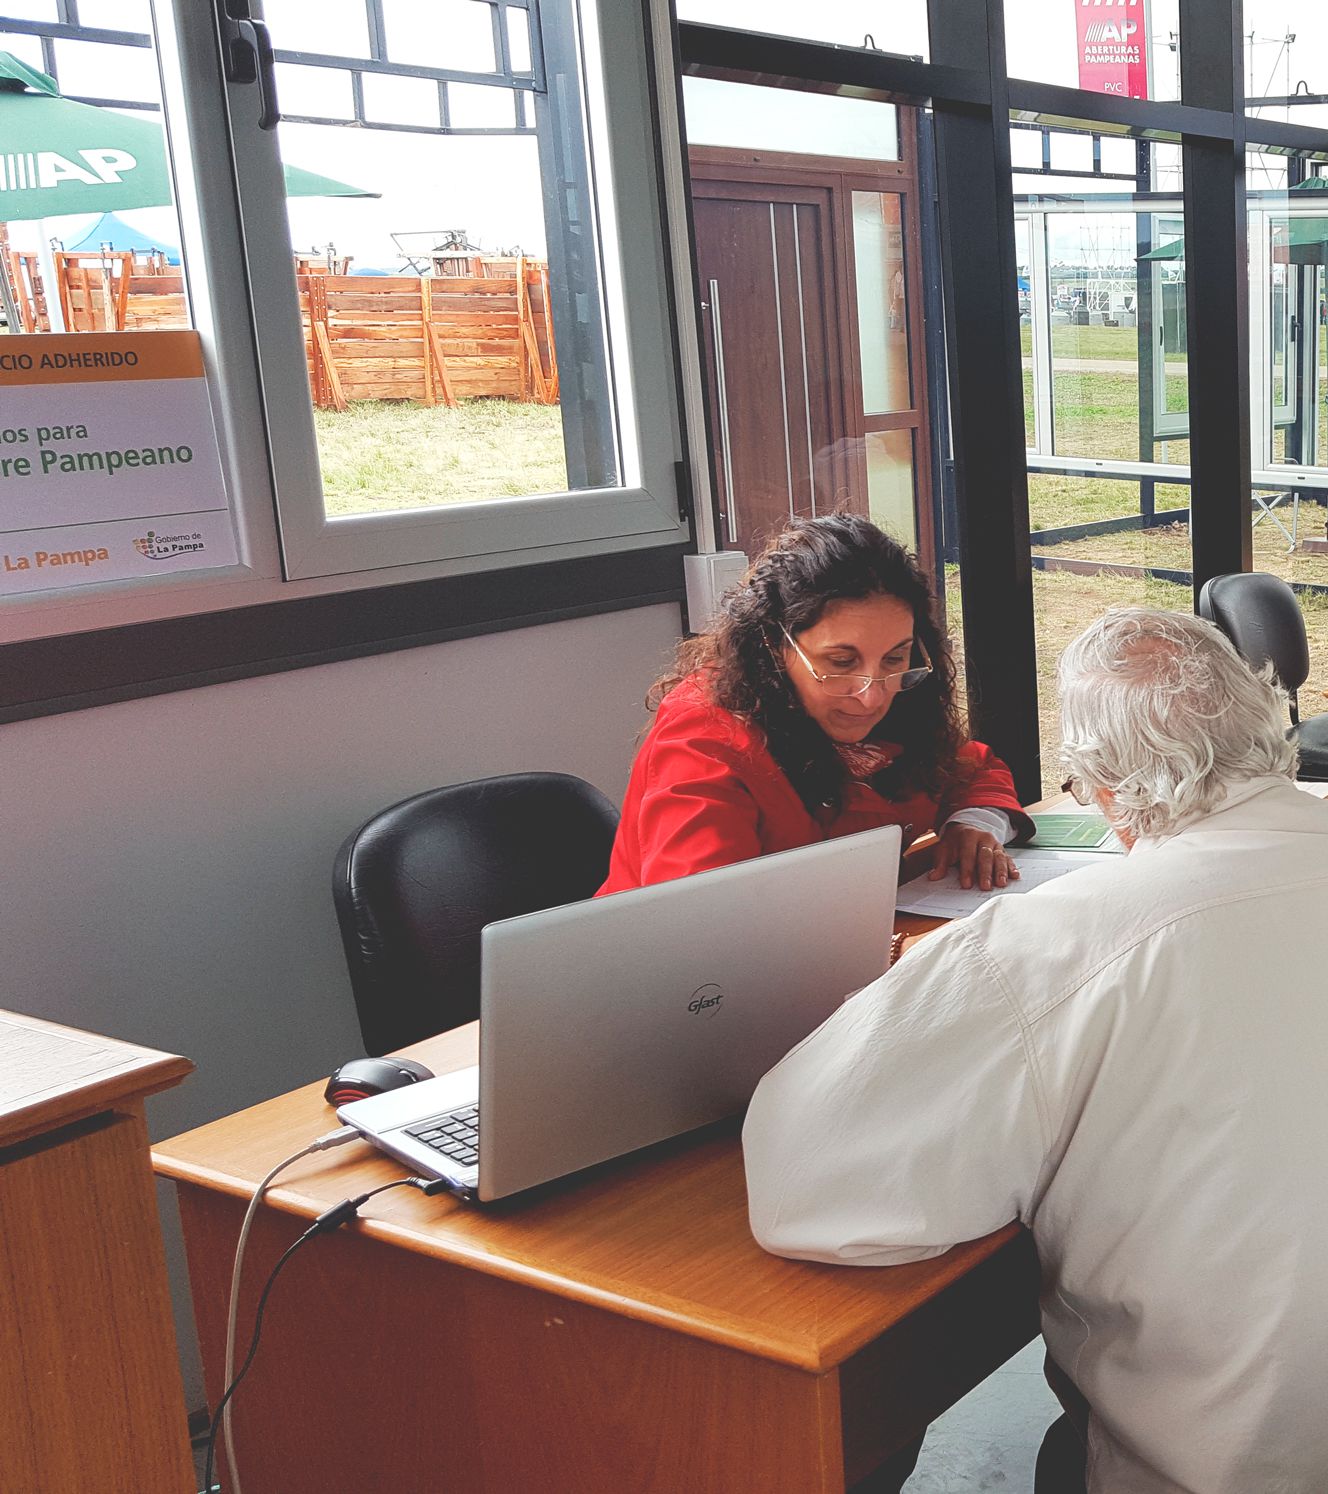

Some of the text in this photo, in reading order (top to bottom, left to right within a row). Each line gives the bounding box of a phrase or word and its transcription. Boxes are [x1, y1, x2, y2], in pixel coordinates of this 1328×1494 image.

[1101, 19, 1137, 42] AP
[1084, 46, 1139, 54] ABERTURAS
[1084, 55, 1140, 63] PAMPEANAS
[1104, 82, 1122, 92] PVC
[36, 148, 137, 188] AP
[40, 351, 139, 369] ADHERIDO
[0, 424, 89, 447] os para
[40, 445, 194, 476] Pampeano
[155, 532, 202, 544] Gobierno de
[171, 542, 204, 552] Pampa
[4, 547, 110, 572] La Pampa
